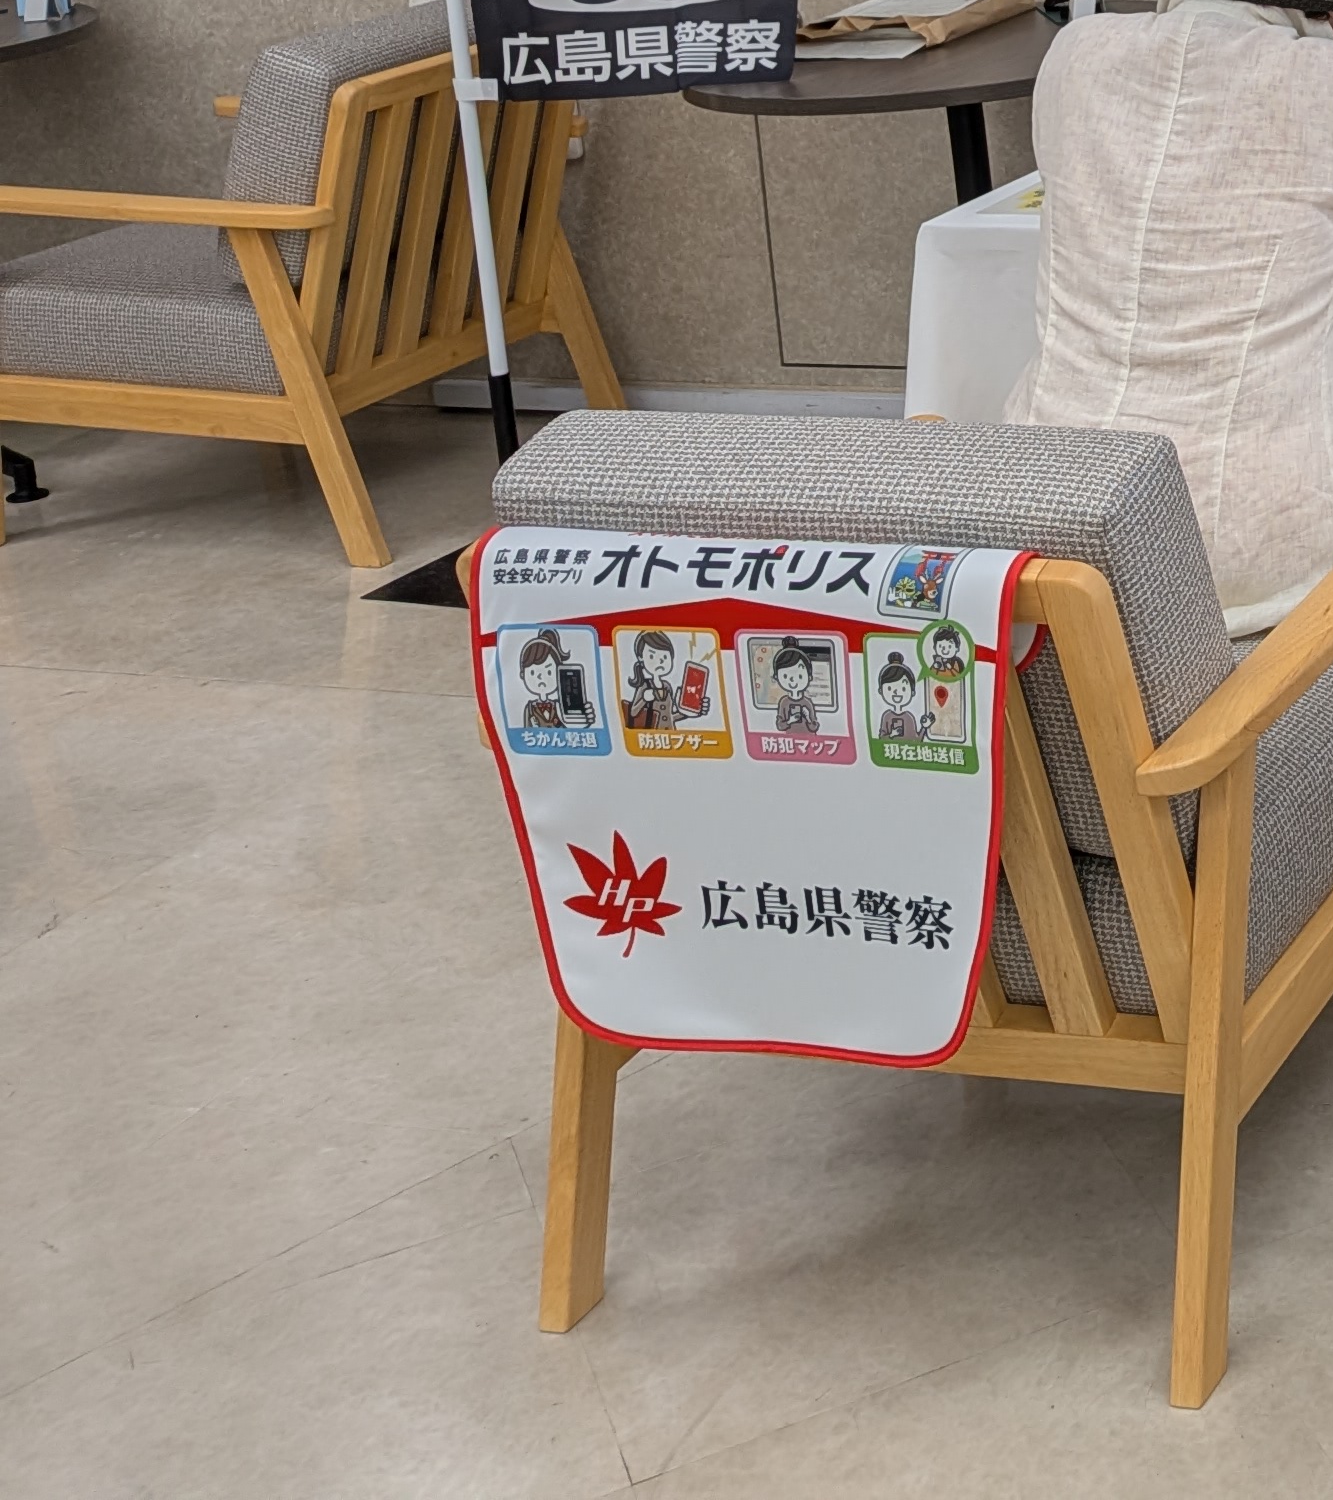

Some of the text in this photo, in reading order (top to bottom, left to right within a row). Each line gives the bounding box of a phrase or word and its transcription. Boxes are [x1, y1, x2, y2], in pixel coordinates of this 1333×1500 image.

[501, 20, 782, 85] 広島県警察
[493, 547, 592, 566] 広島県警察
[492, 567, 585, 586] 安全安心アプリ
[593, 544, 877, 596] オトモポリス
[520, 730, 598, 750] ちかん撃退
[637, 732, 719, 752] 防犯ブザー
[761, 734, 841, 756] 防犯マップ
[883, 744, 966, 768] 現在地送信
[700, 879, 955, 951] 広島県警察
